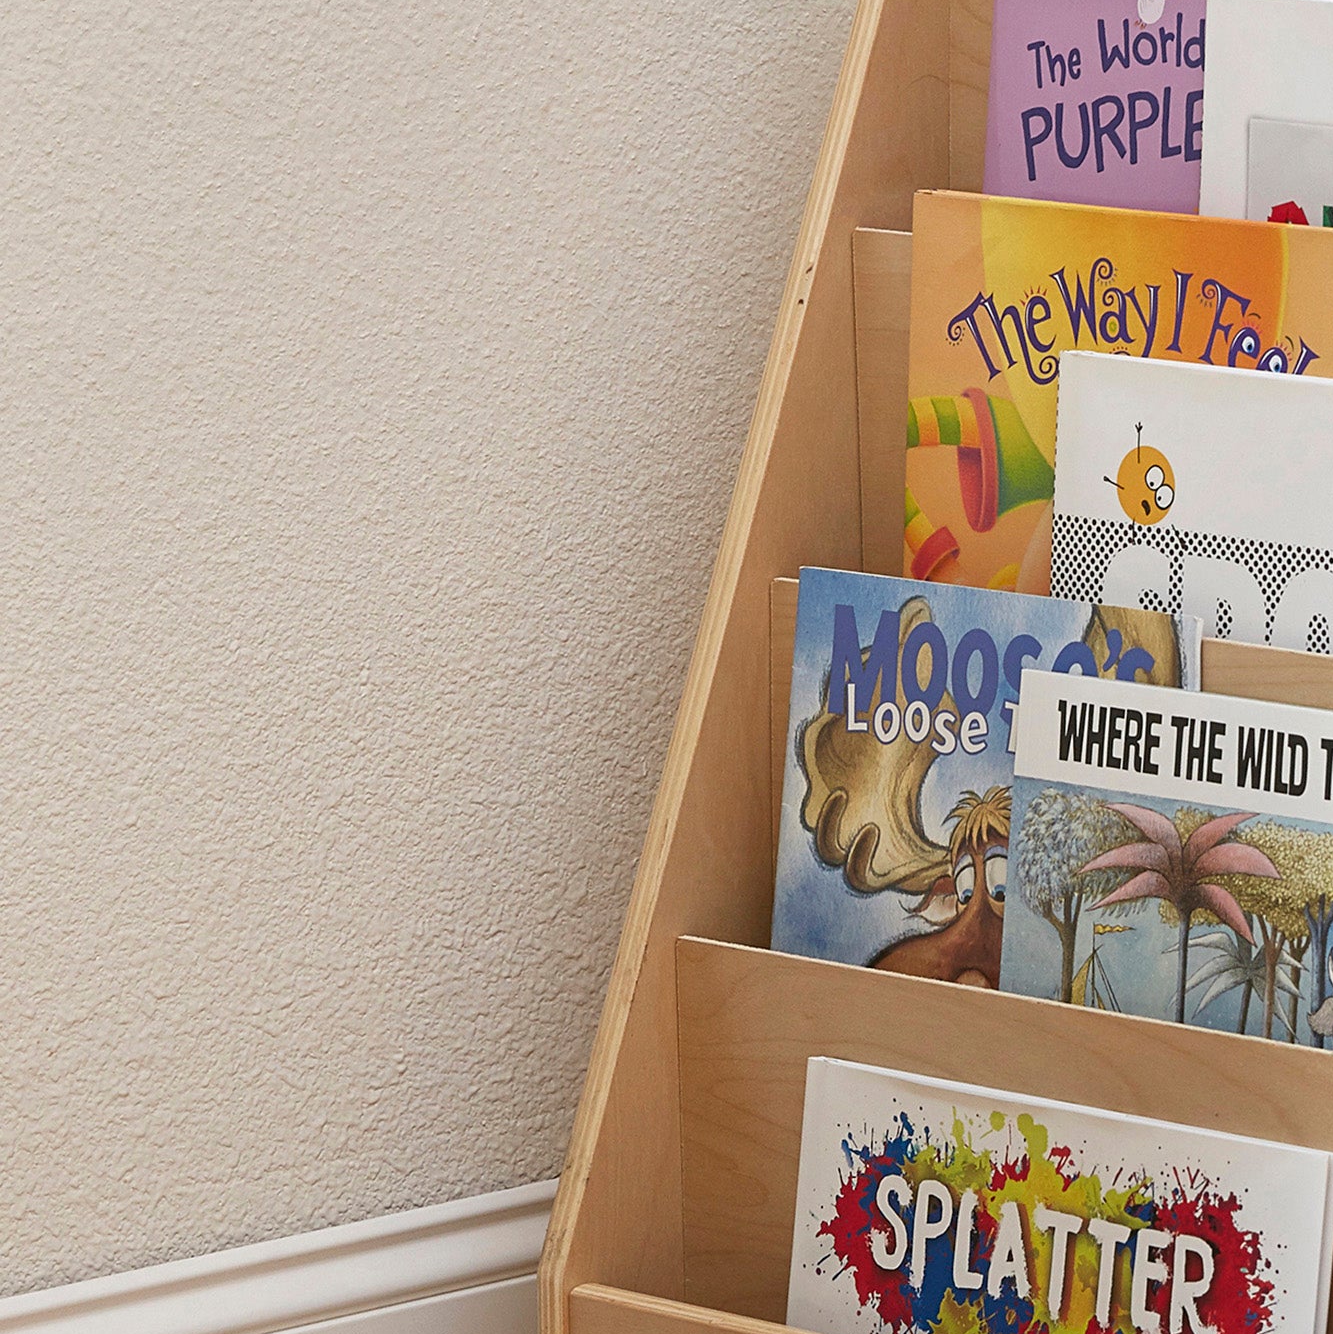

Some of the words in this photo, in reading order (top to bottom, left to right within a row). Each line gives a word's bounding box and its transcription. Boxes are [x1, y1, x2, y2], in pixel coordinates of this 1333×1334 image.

[1027, 40, 1082, 89] The
[1097, 12, 1206, 73] World
[1021, 86, 1204, 181] PURPLE
[946, 286, 1060, 385] The
[1049, 257, 1162, 358] Way
[1165, 268, 1195, 355] I
[846, 682, 989, 755] Loose
[1058, 699, 1162, 775] WHERE
[1171, 716, 1226, 784] THE
[1237, 725, 1309, 796] WILD
